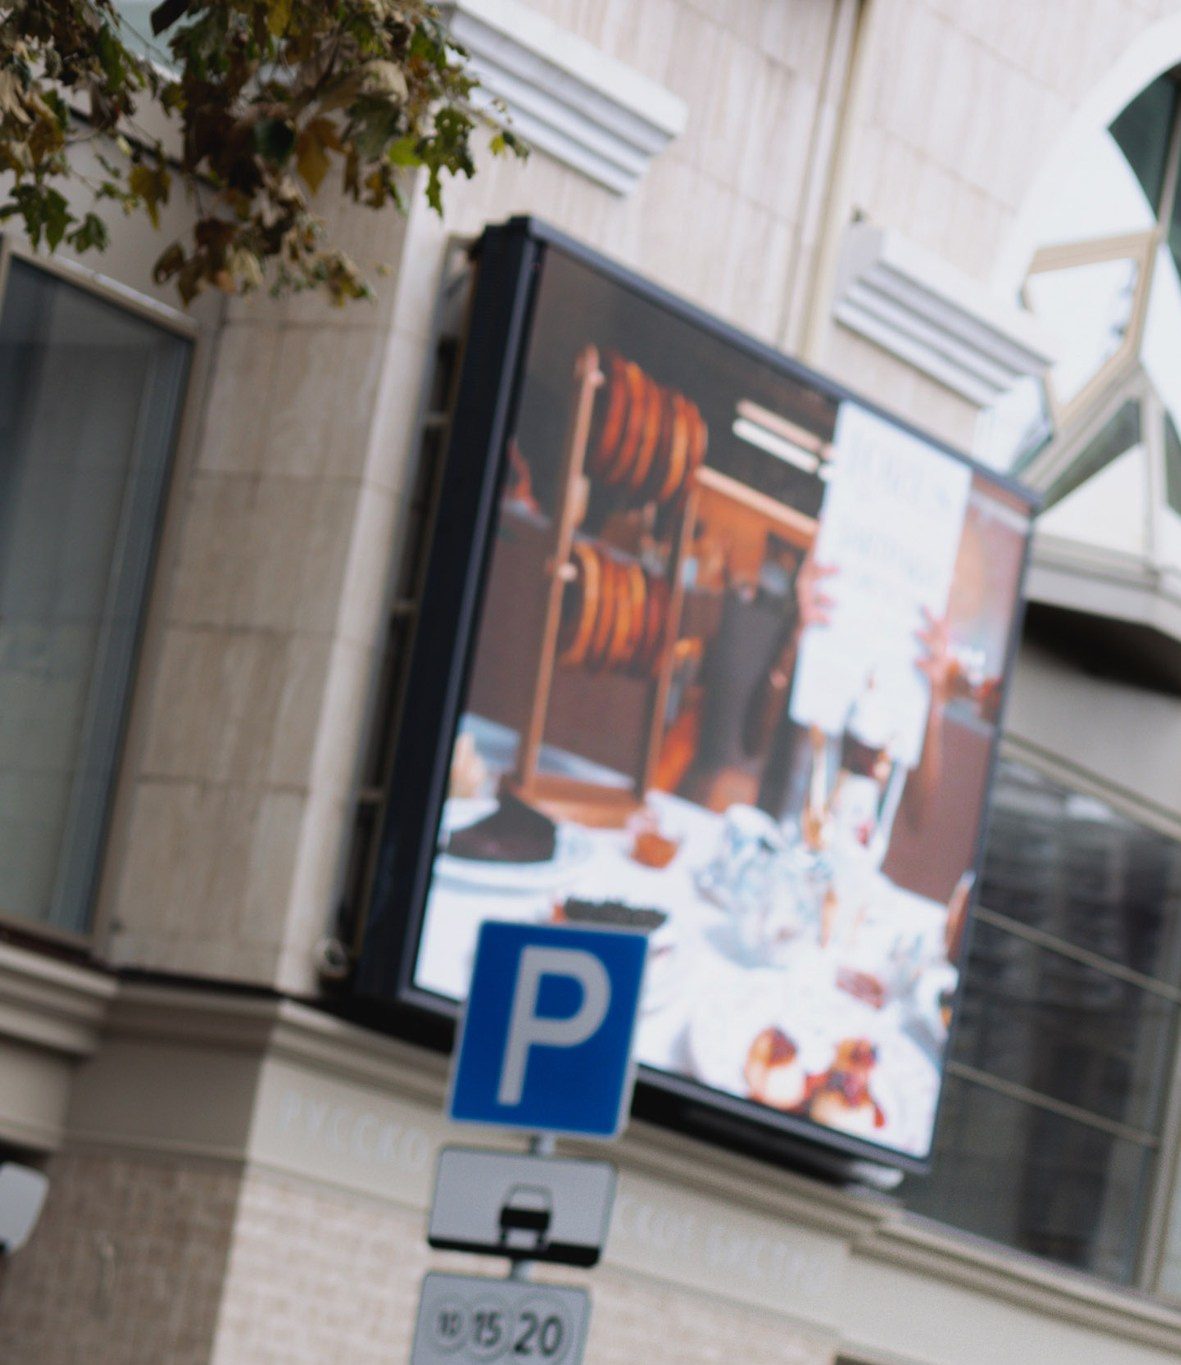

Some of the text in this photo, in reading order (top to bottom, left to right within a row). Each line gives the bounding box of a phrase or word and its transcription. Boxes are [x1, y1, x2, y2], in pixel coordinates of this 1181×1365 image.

[497, 944, 611, 1107] P
[472, 1310, 501, 1347] 15
[513, 1310, 564, 1357] 20
